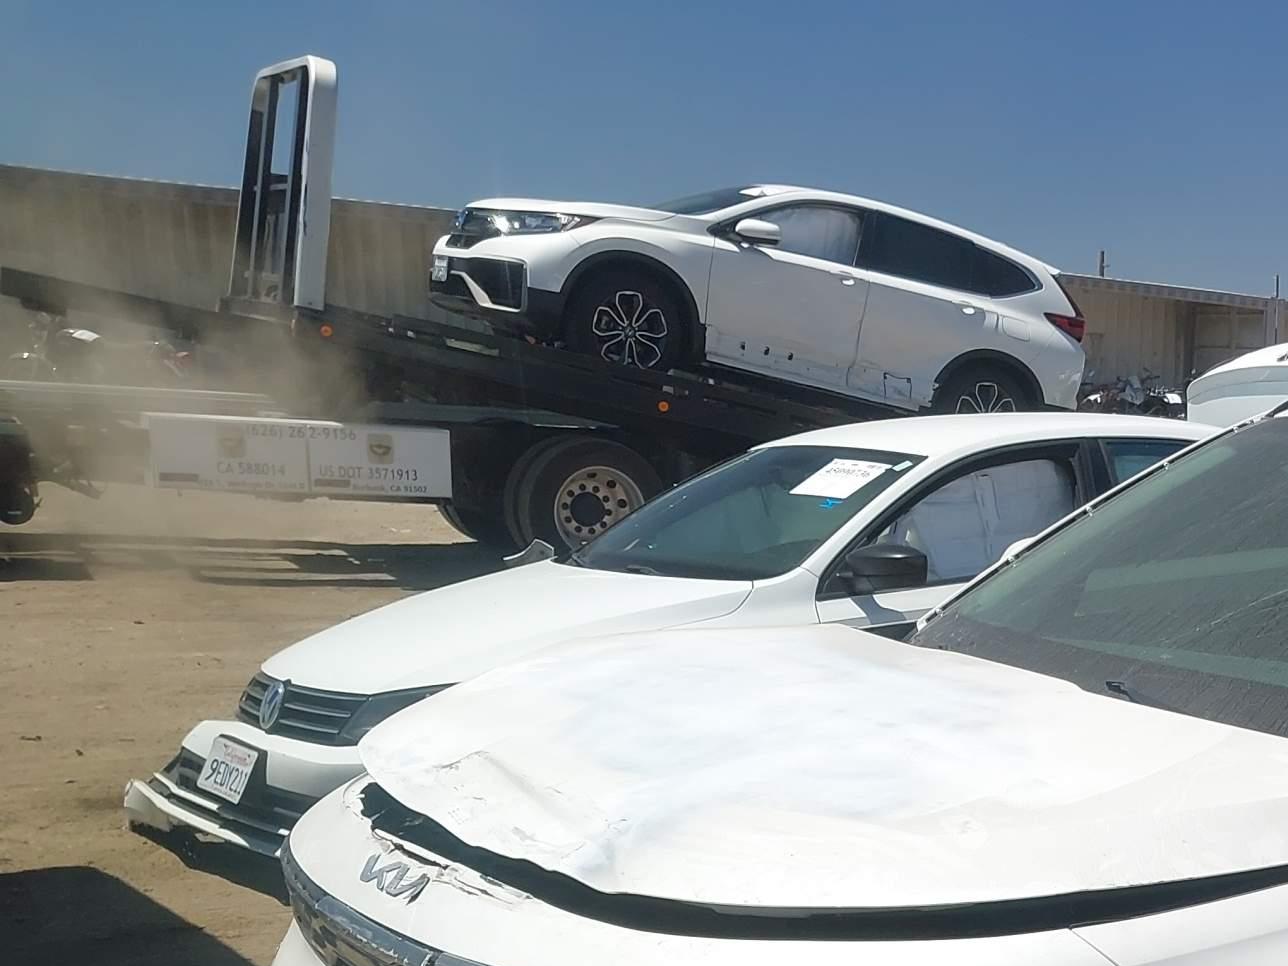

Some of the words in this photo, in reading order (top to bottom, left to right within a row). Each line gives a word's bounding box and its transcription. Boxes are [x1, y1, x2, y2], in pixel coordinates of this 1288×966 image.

[245, 425, 284, 439] (626)
[217, 461, 235, 474] CA
[239, 462, 286, 476] 588014
[319, 465, 336, 478] US
[338, 466, 362, 479] DOT
[367, 467, 419, 482] 3571913
[205, 758, 248, 796] 9EDY211
